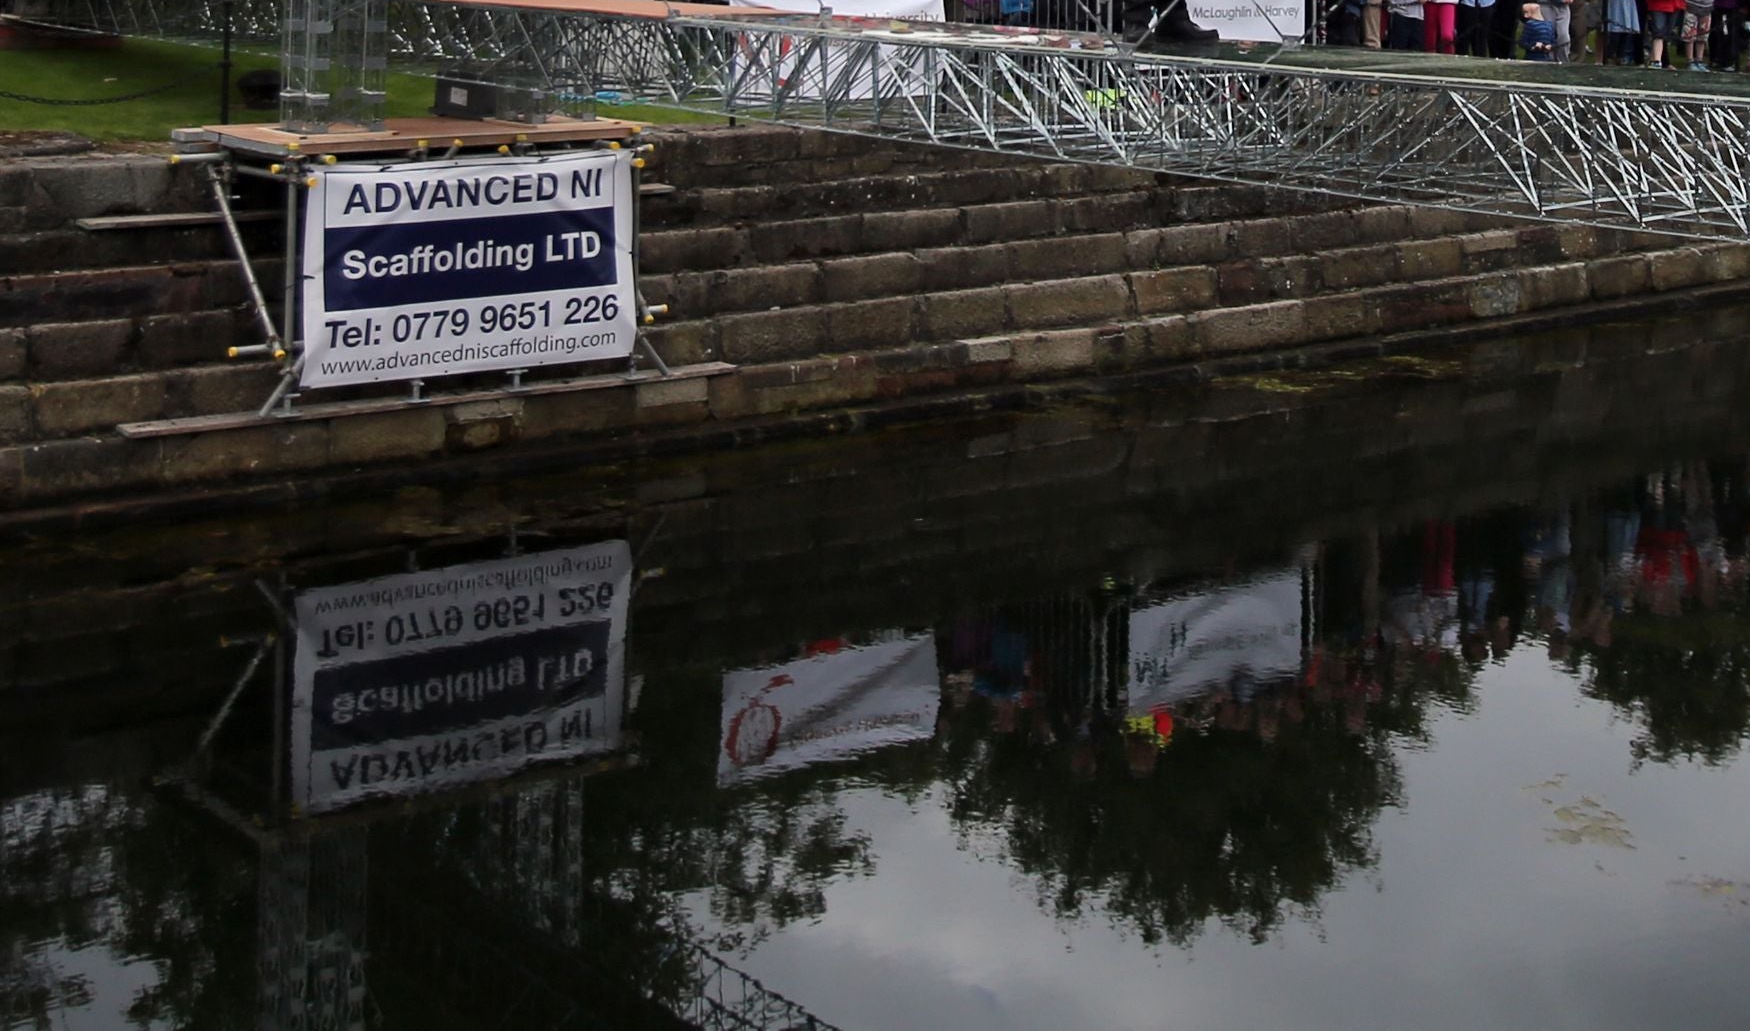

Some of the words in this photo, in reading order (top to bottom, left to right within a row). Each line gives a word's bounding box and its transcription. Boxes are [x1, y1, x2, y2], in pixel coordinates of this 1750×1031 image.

[865, 10, 940, 22] ersity
[1192, 6, 1252, 20] McLaughlin
[1265, 5, 1299, 19] Harvey
[343, 171, 558, 215] ADVANCED
[572, 168, 602, 198] NI
[342, 239, 534, 280] Scaffolding
[546, 230, 601, 262] LTD
[325, 319, 381, 349] Tel:
[392, 308, 469, 342] 0779
[480, 300, 552, 334] 9651
[564, 294, 618, 325] 226
[321, 330, 616, 375] www.advancedniscaffolding.com
